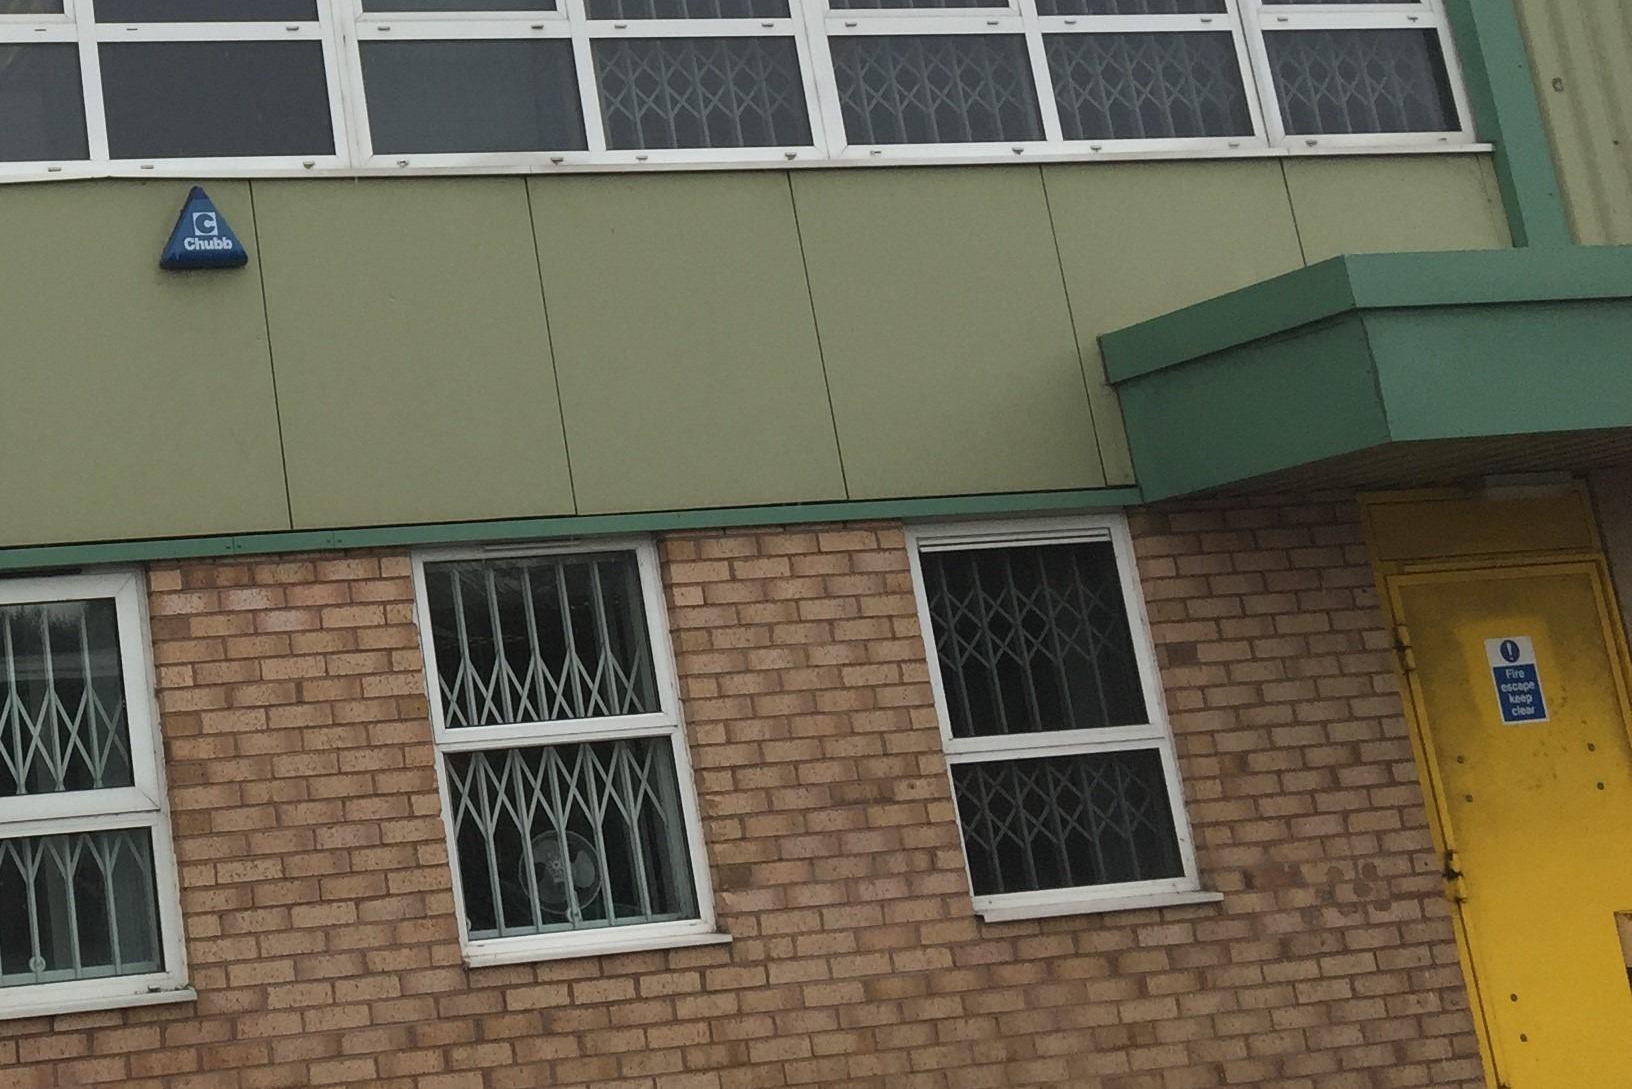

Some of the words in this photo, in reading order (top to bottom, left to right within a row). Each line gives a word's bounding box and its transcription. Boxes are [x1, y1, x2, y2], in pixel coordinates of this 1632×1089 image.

[184, 237, 232, 250] Chubb
[1506, 668, 1525, 679] Fire
[1501, 681, 1535, 692] escape
[1509, 693, 1533, 704] keep
[1512, 706, 1535, 716] clear
